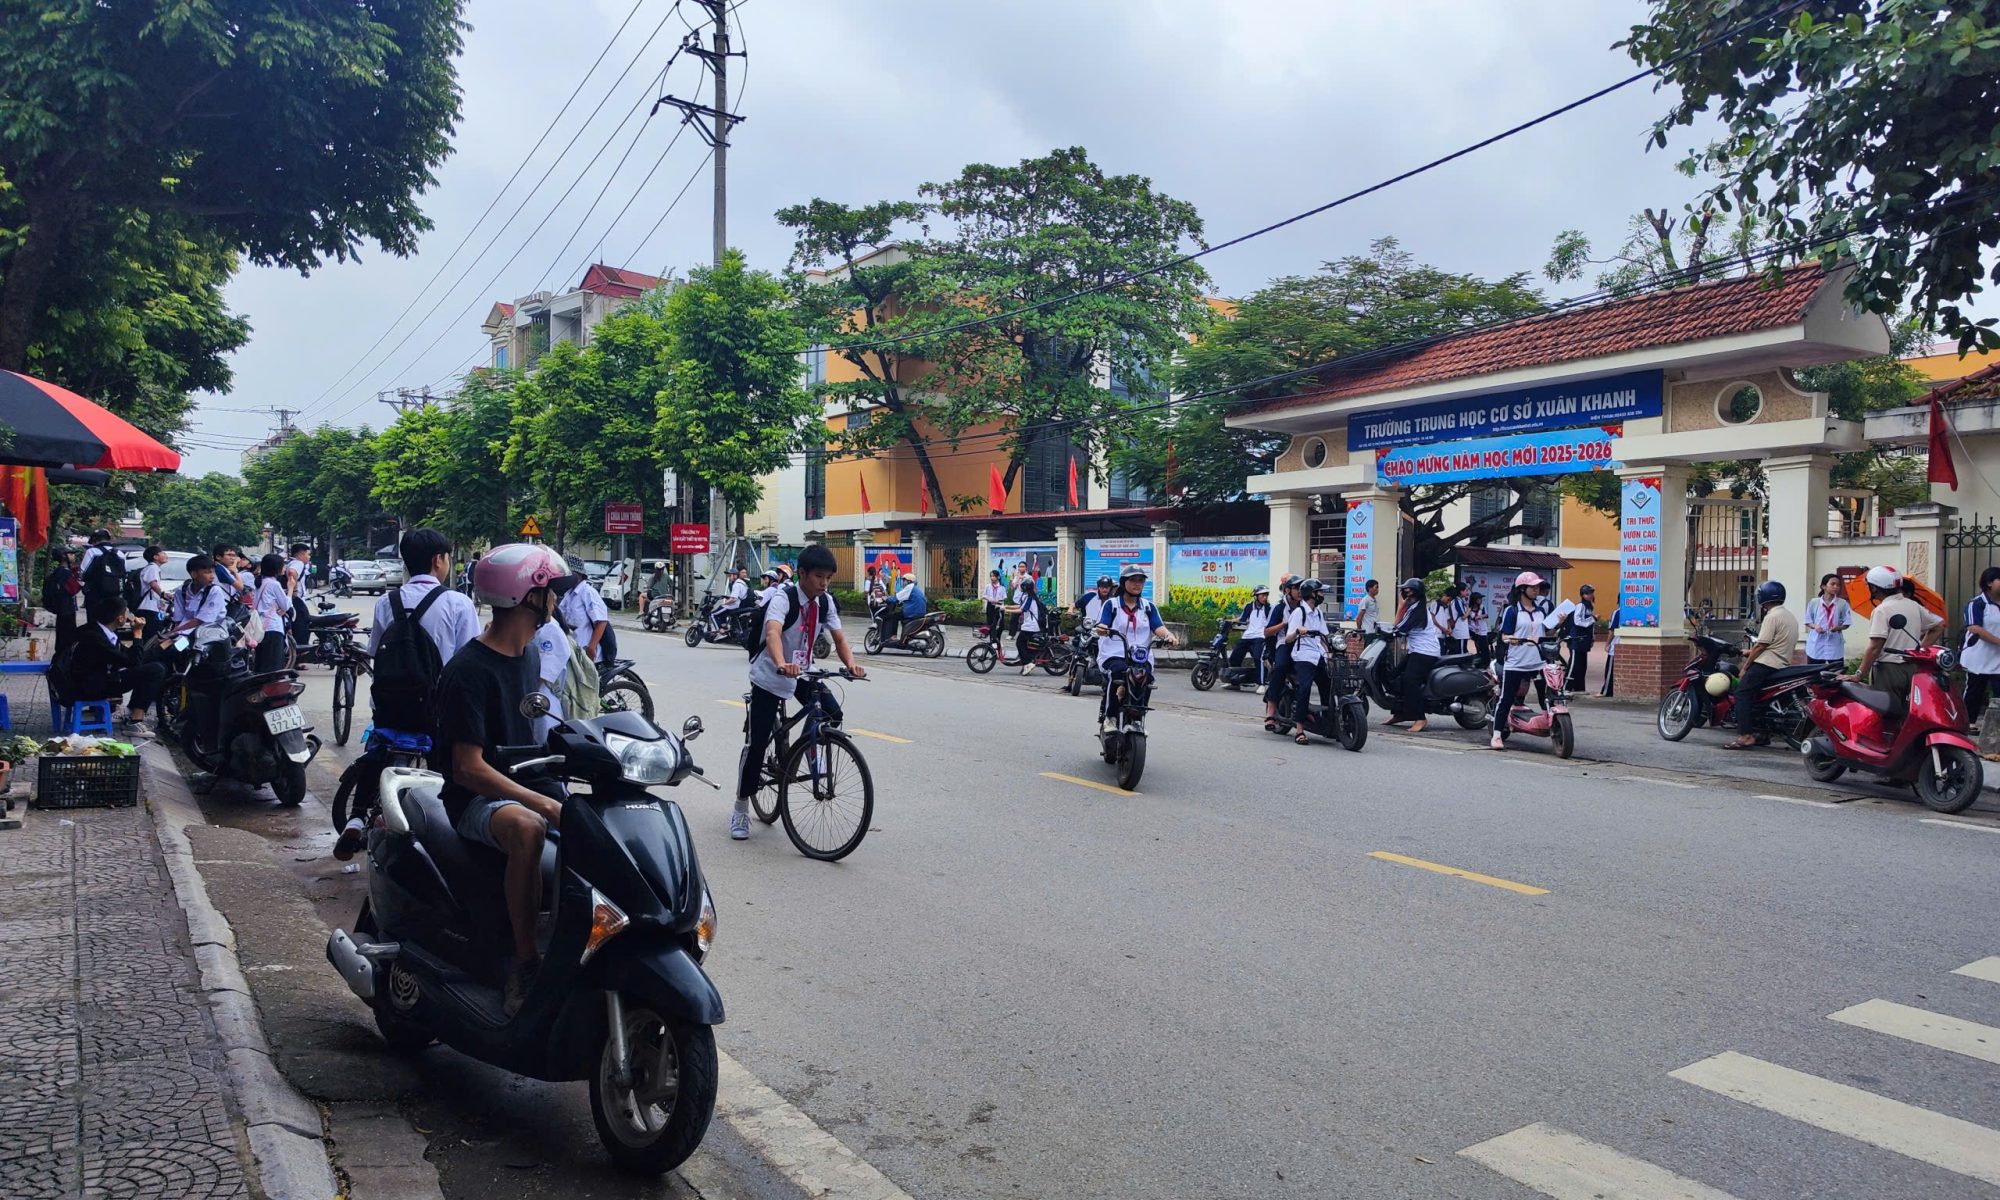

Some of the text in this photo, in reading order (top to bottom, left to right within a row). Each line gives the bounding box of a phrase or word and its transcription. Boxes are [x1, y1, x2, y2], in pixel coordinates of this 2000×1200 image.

[1364, 418, 1411, 439] TRƯỜNG
[1414, 413, 1456, 433] TRUNG
[1459, 409, 1486, 429] HỌC
[1490, 404, 1510, 423] CƠ
[1512, 396, 1533, 421] SỞ
[1535, 395, 1577, 418] XUÂN
[1581, 389, 1636, 412] KHANH
[1384, 441, 1612, 478] CHÀO MỪNG NĂM HỌC MỚI 2025-2026
[1201, 561, 1217, 572] 20
[1224, 561, 1233, 572] 11
